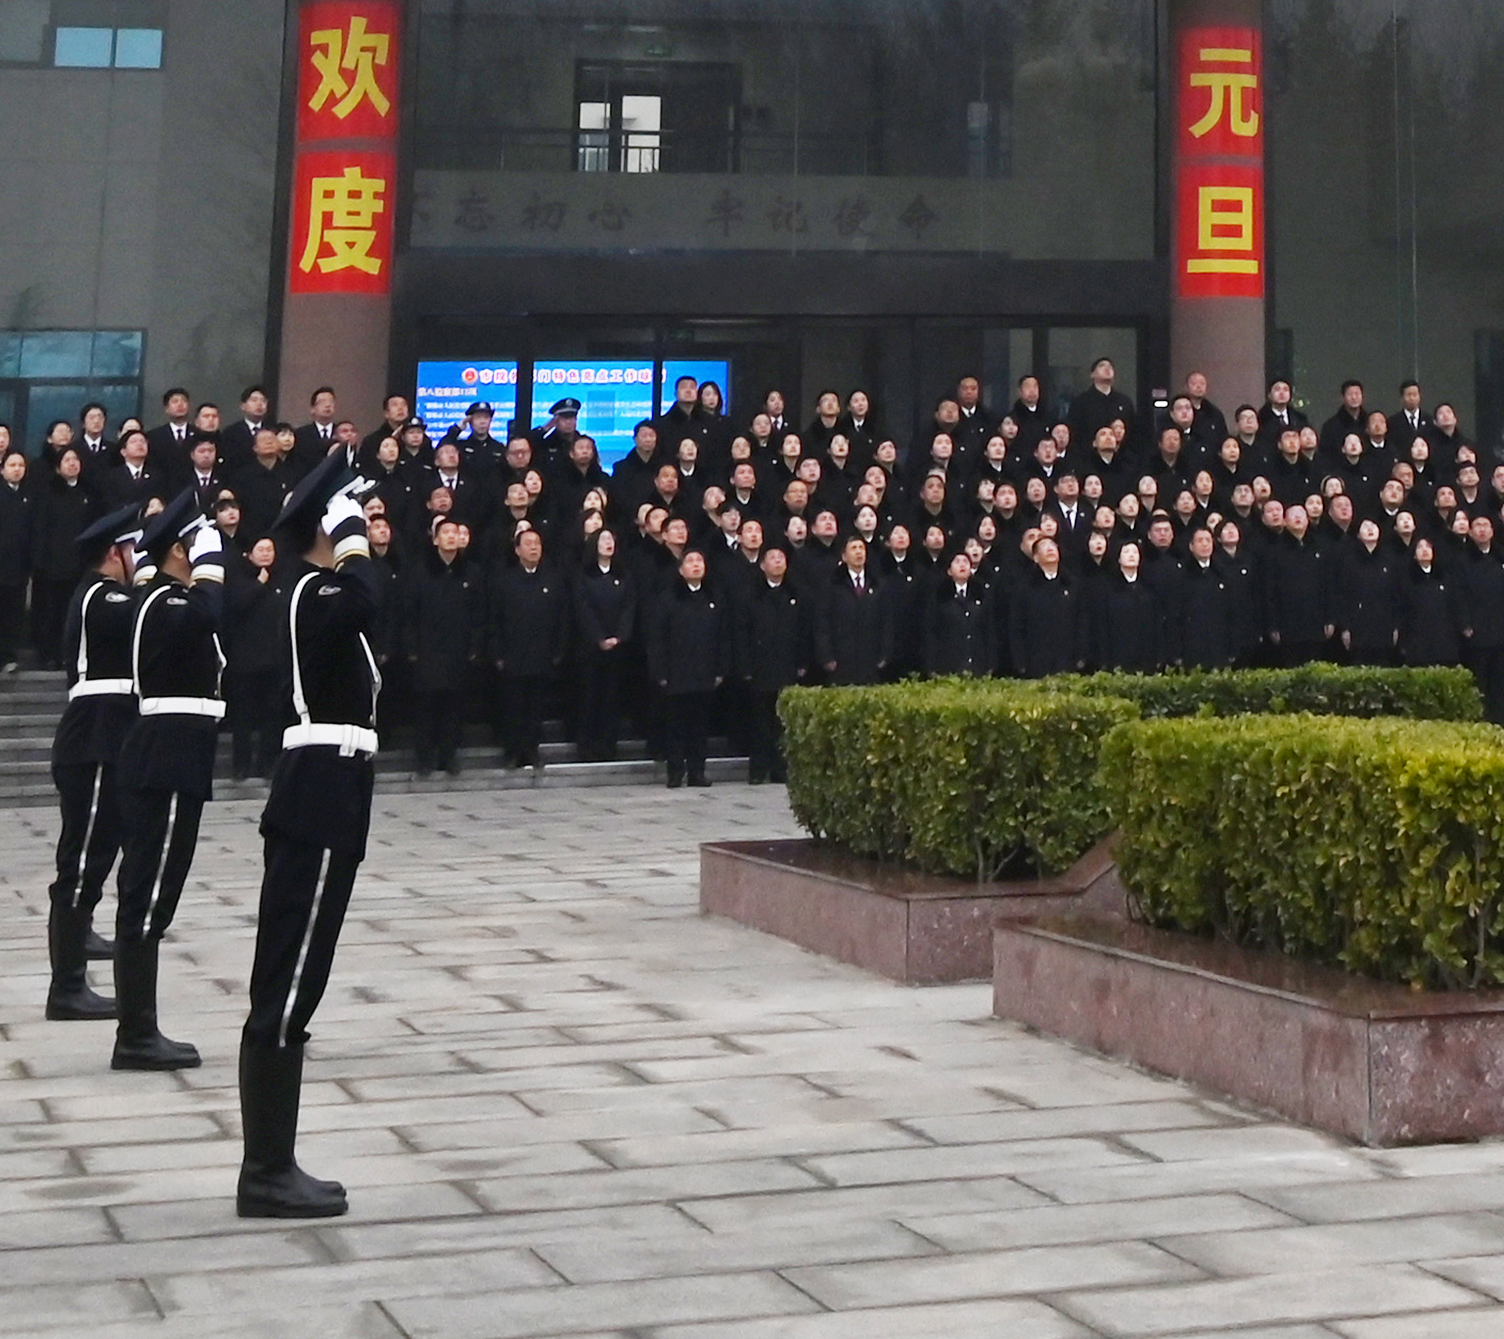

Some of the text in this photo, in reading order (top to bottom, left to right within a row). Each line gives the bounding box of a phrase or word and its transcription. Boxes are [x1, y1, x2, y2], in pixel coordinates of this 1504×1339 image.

[299, 17, 391, 275] 欢度
[702, 188, 941, 240] 牢记使命
[1187, 48, 1259, 274] 元旦
